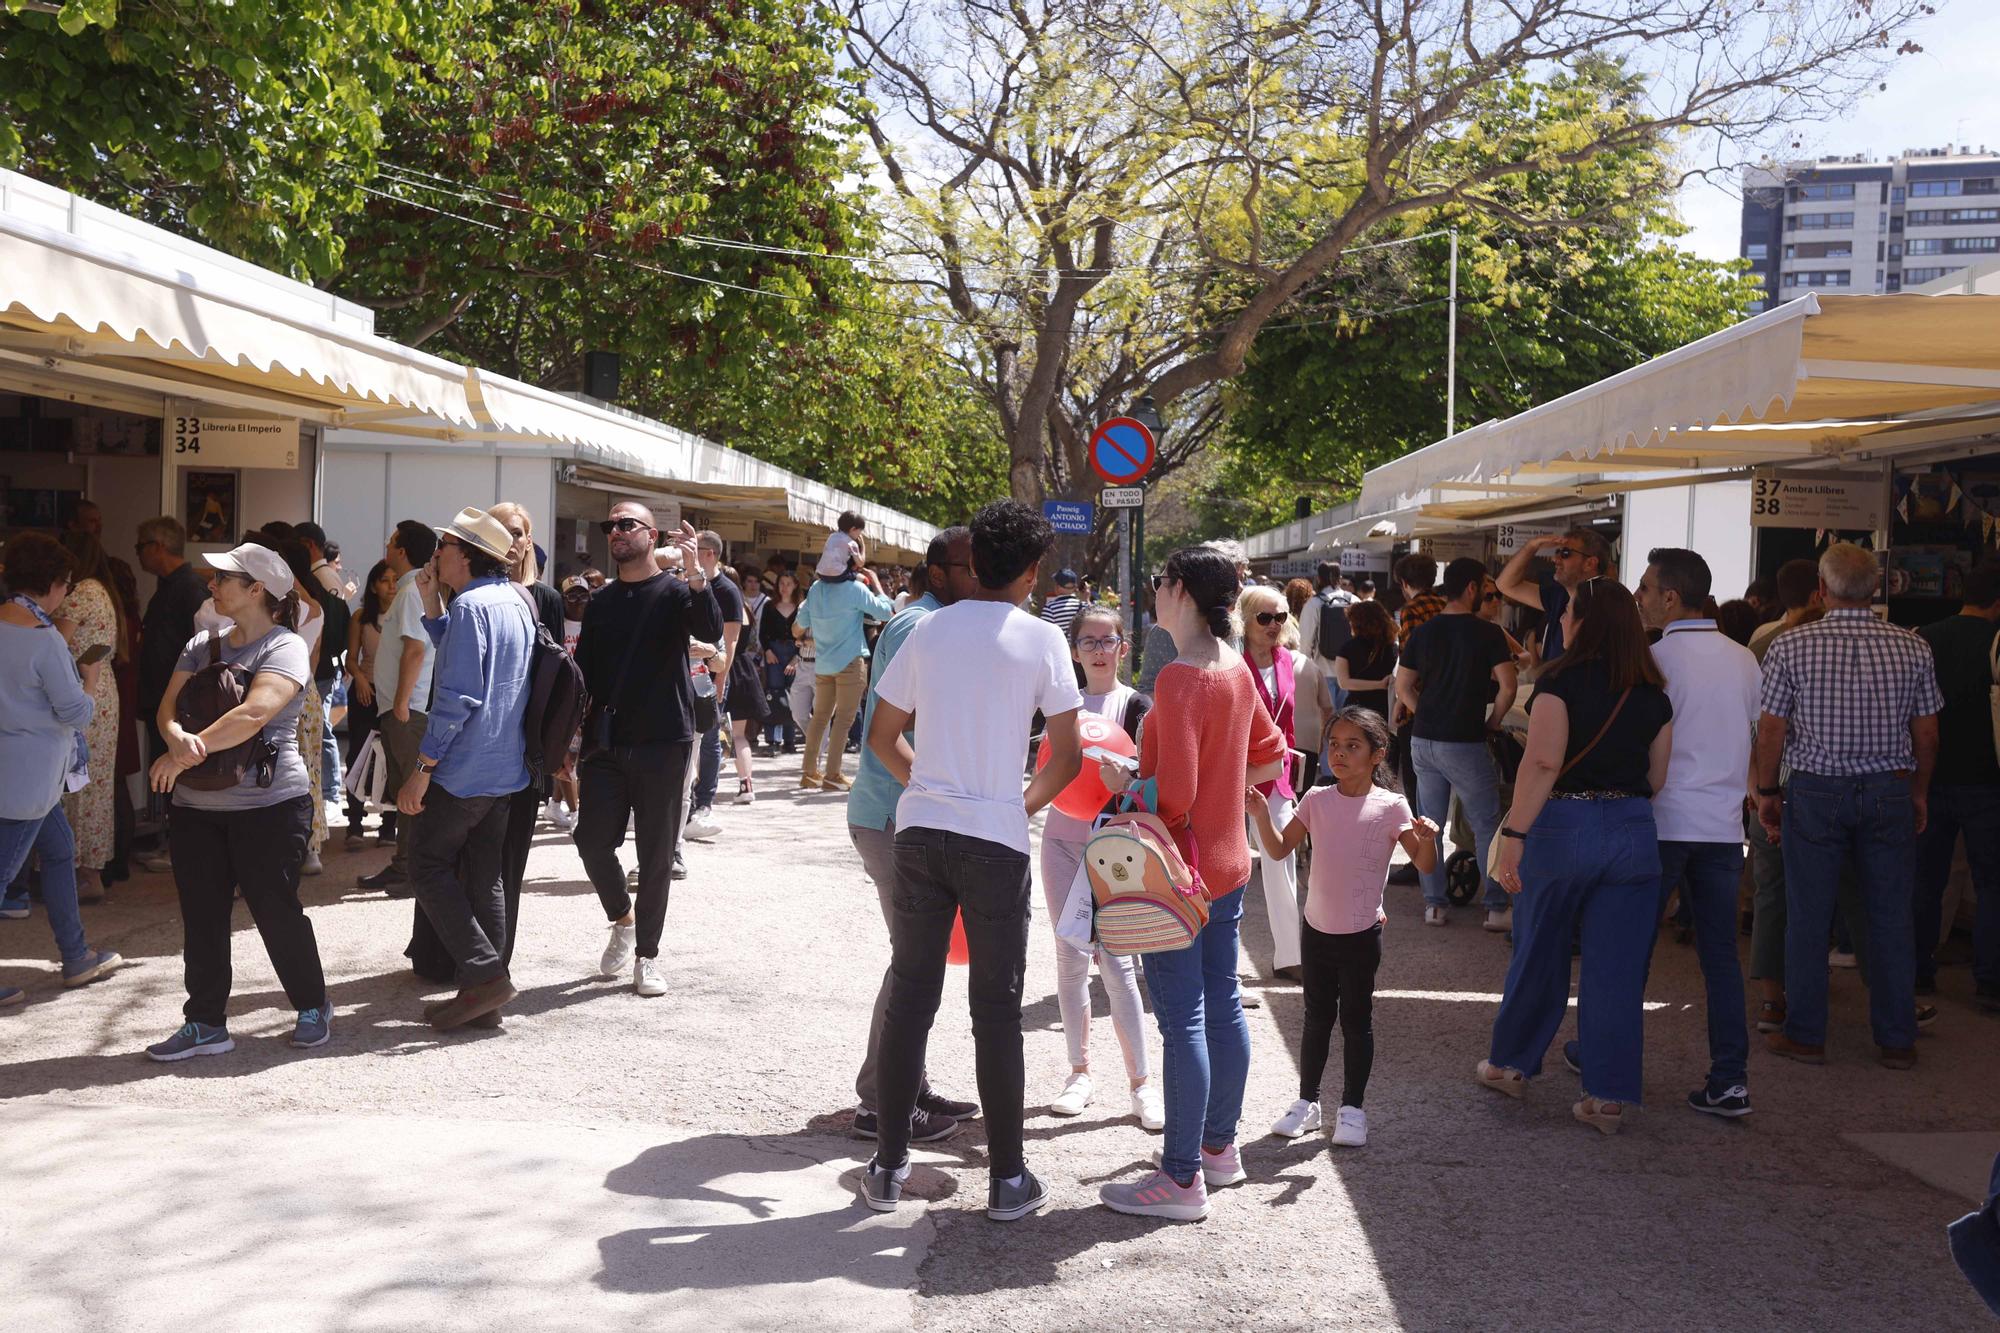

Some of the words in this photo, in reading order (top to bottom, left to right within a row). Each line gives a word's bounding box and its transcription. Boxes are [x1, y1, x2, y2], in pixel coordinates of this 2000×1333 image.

[175, 417, 200, 435] 33
[237, 424, 246, 433] El
[247, 424, 282, 434] Imperio
[175, 436, 200, 454] 34
[1755, 479, 1782, 496] 37
[1783, 484, 1813, 494] Ambra
[1815, 485, 1845, 495] Llibres
[1056, 505, 1081, 514] Passeig
[1754, 498, 1780, 515] 38
[1051, 513, 1086, 521] ANTONIO
[1499, 525, 1514, 536] 39
[1421, 538, 1433, 547] 39
[1499, 537, 1514, 548] 40
